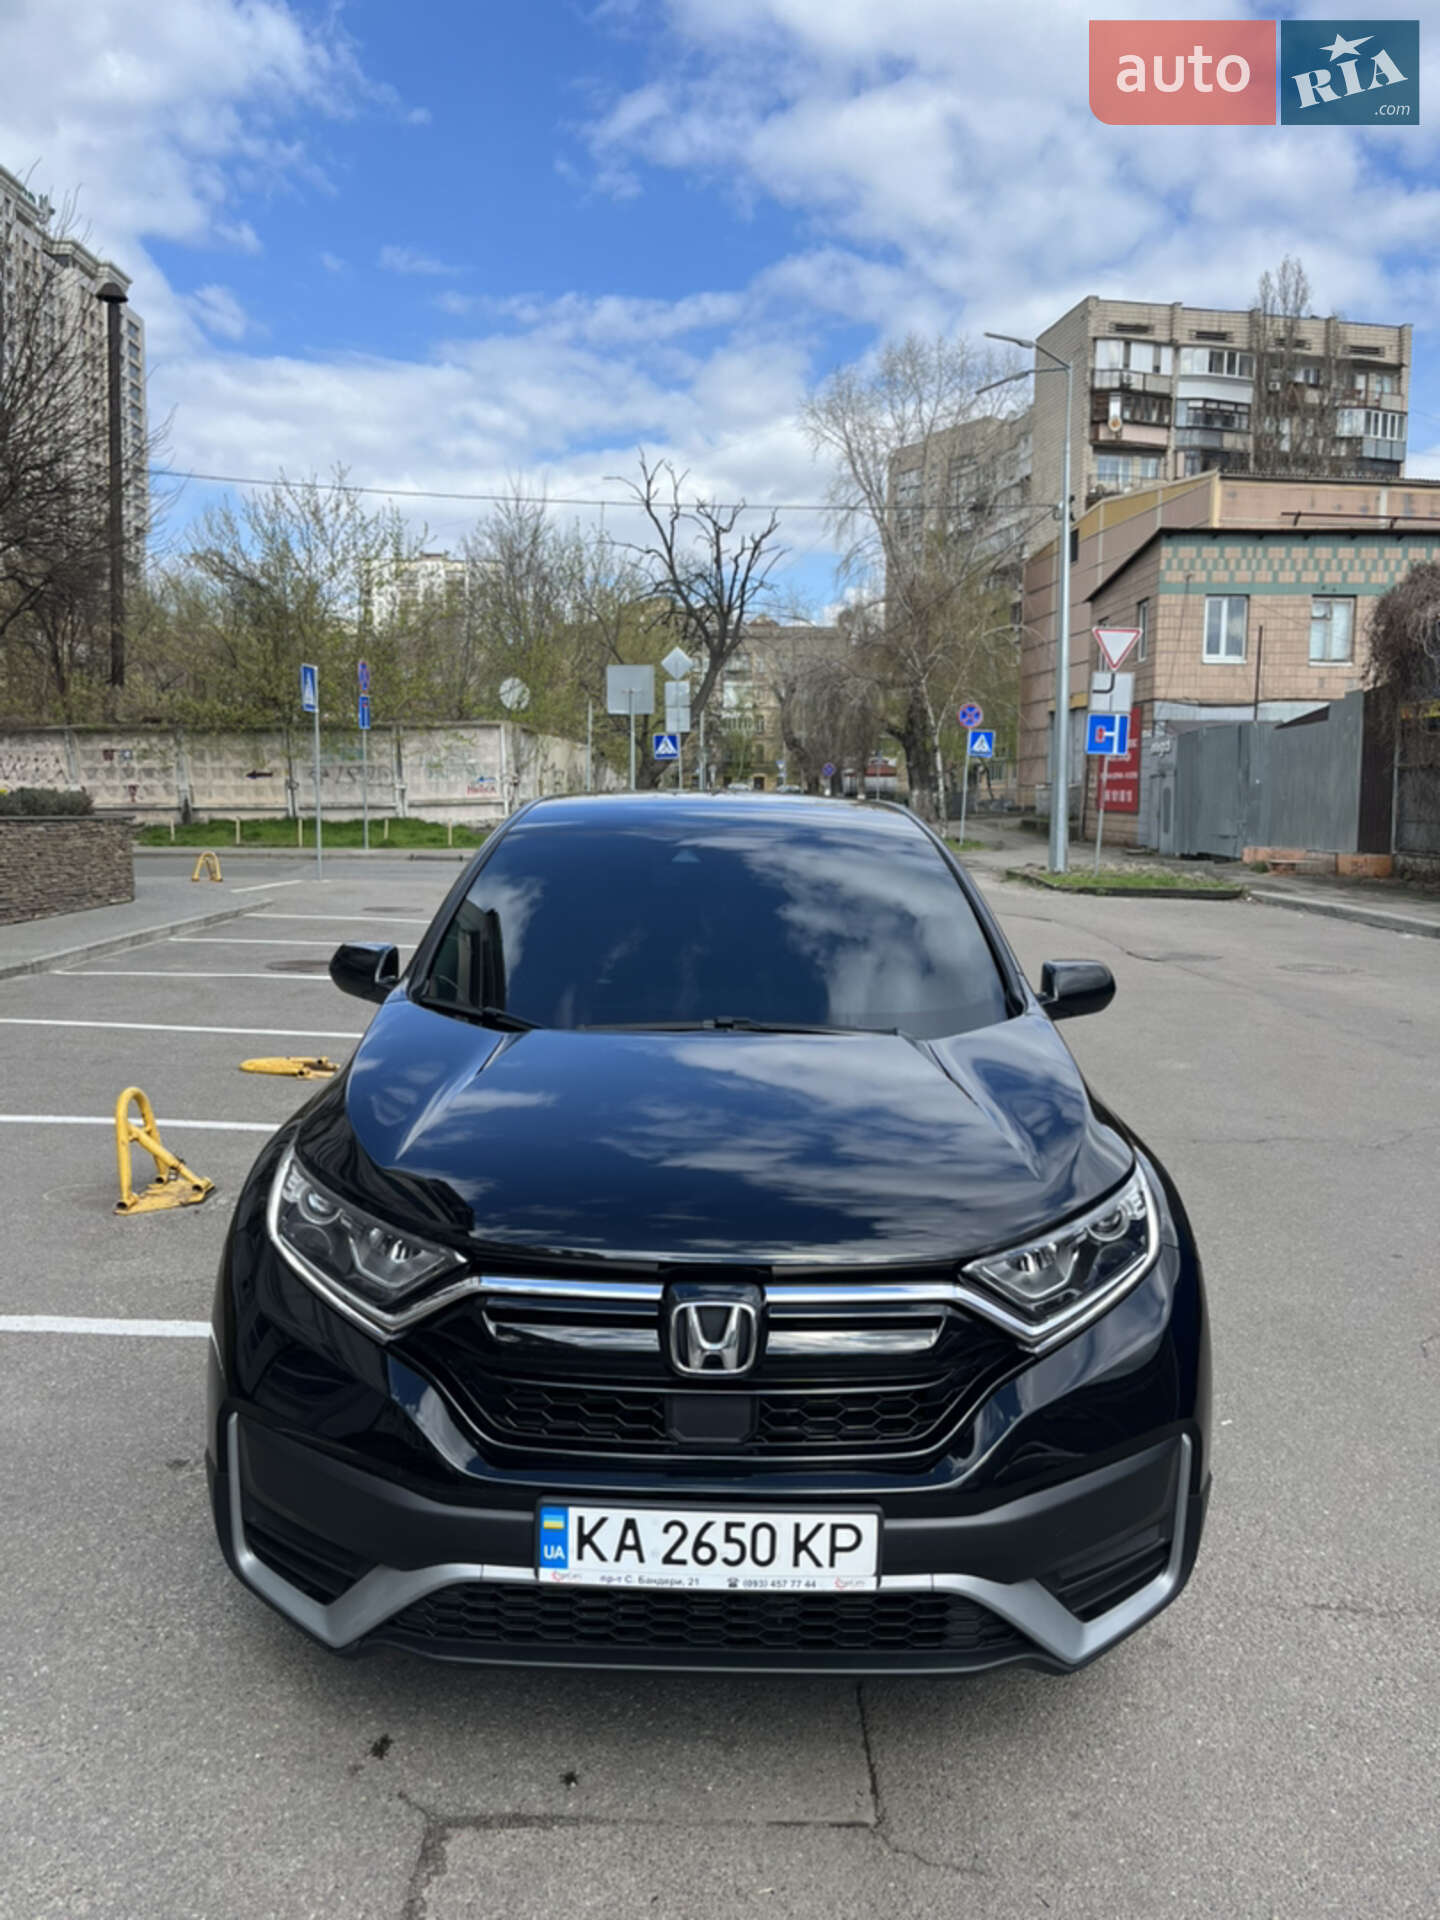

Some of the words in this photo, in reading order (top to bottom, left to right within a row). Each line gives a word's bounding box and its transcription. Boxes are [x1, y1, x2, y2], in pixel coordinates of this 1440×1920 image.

[576, 1515, 645, 1563] KA
[661, 1520, 777, 1568] 2650
[793, 1522, 863, 1569] KP
[543, 1545, 566, 1560] UA
[688, 1577, 700, 1586] 21
[770, 1578, 787, 1588] 457
[790, 1579, 801, 1588] 77
[804, 1579, 816, 1588] 44
